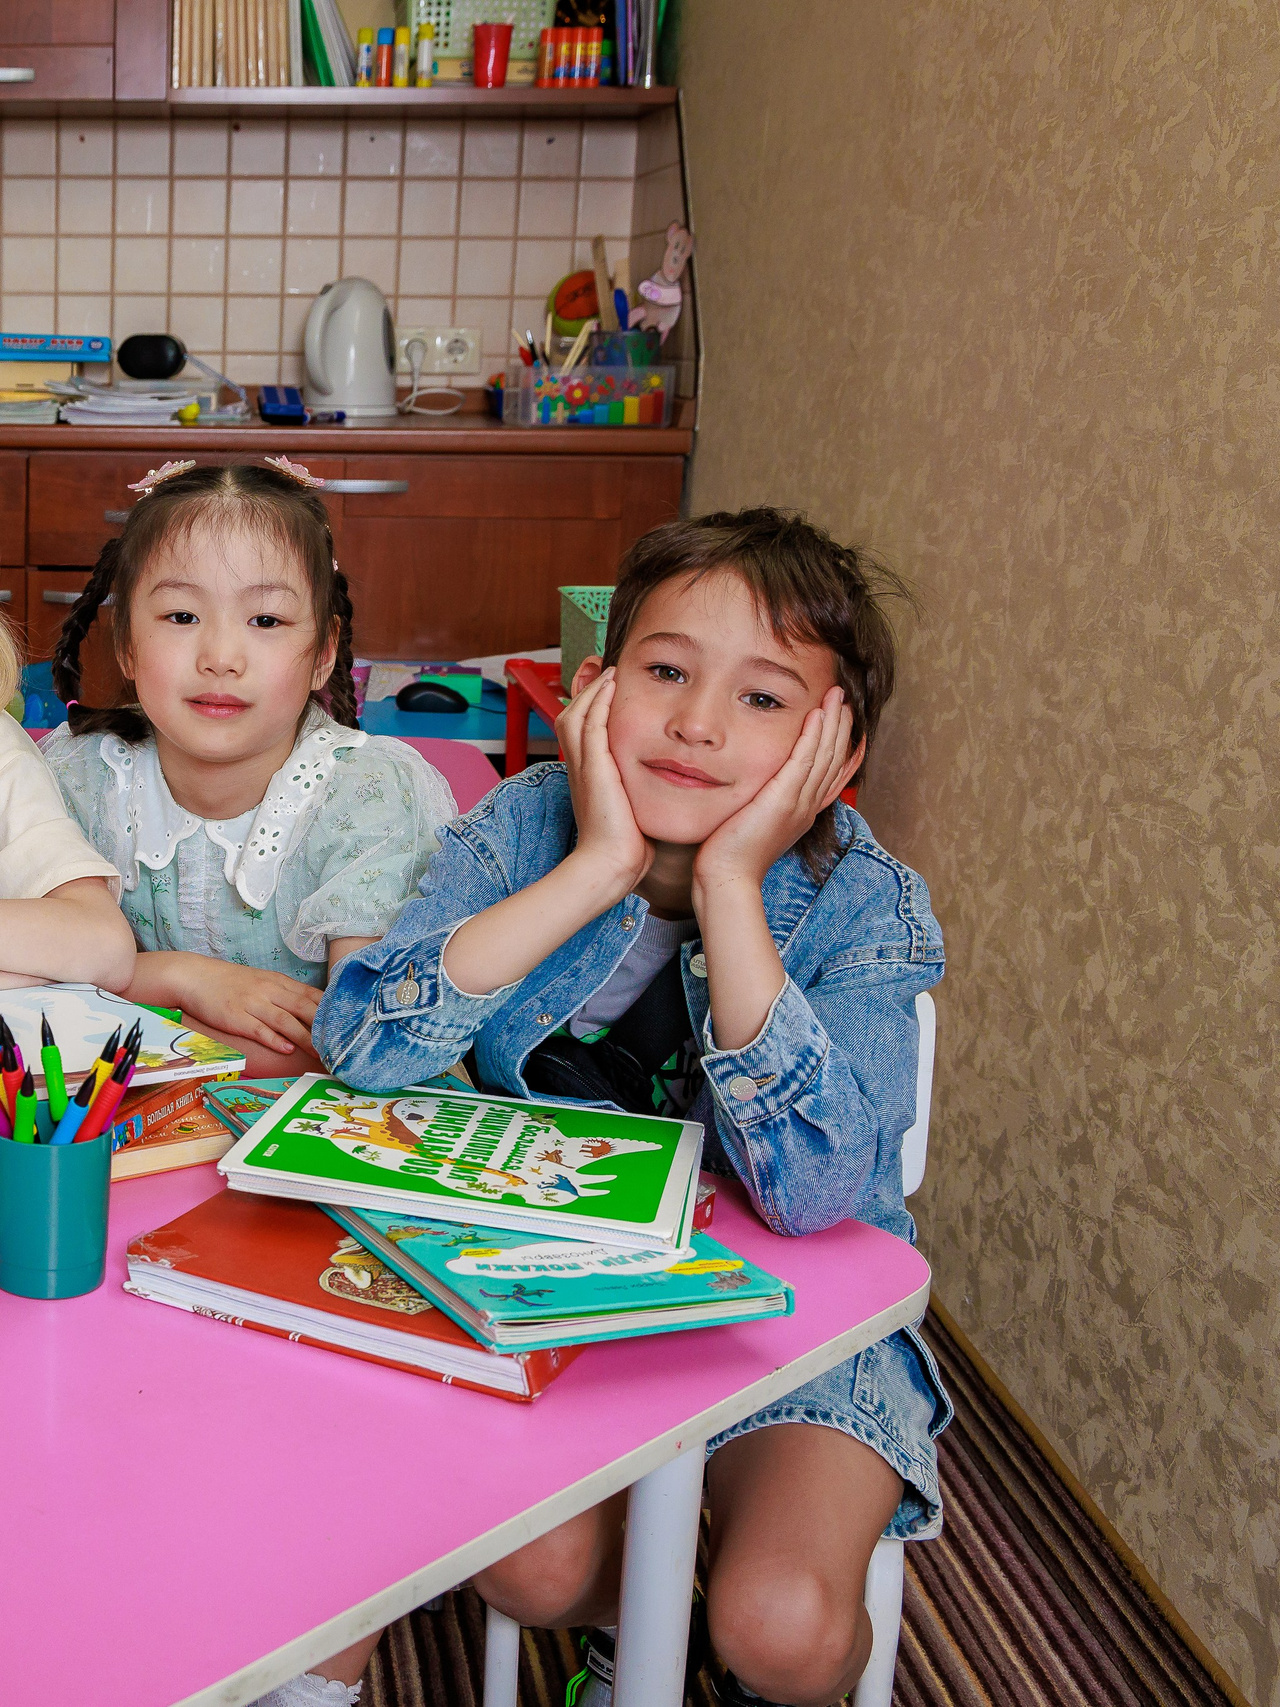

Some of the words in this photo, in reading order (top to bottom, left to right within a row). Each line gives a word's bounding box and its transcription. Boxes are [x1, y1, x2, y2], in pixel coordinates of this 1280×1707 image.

[147, 1102, 175, 1127] БОЛЬШАЯ
[175, 1093, 194, 1110] КНИГА
[398, 1099, 479, 1176] ДИНОЗАВРОВ
[446, 1106, 518, 1183] ЭНЦИКЛОПЕДИЯ
[475, 1262, 584, 1272] ПОКАЖИ
